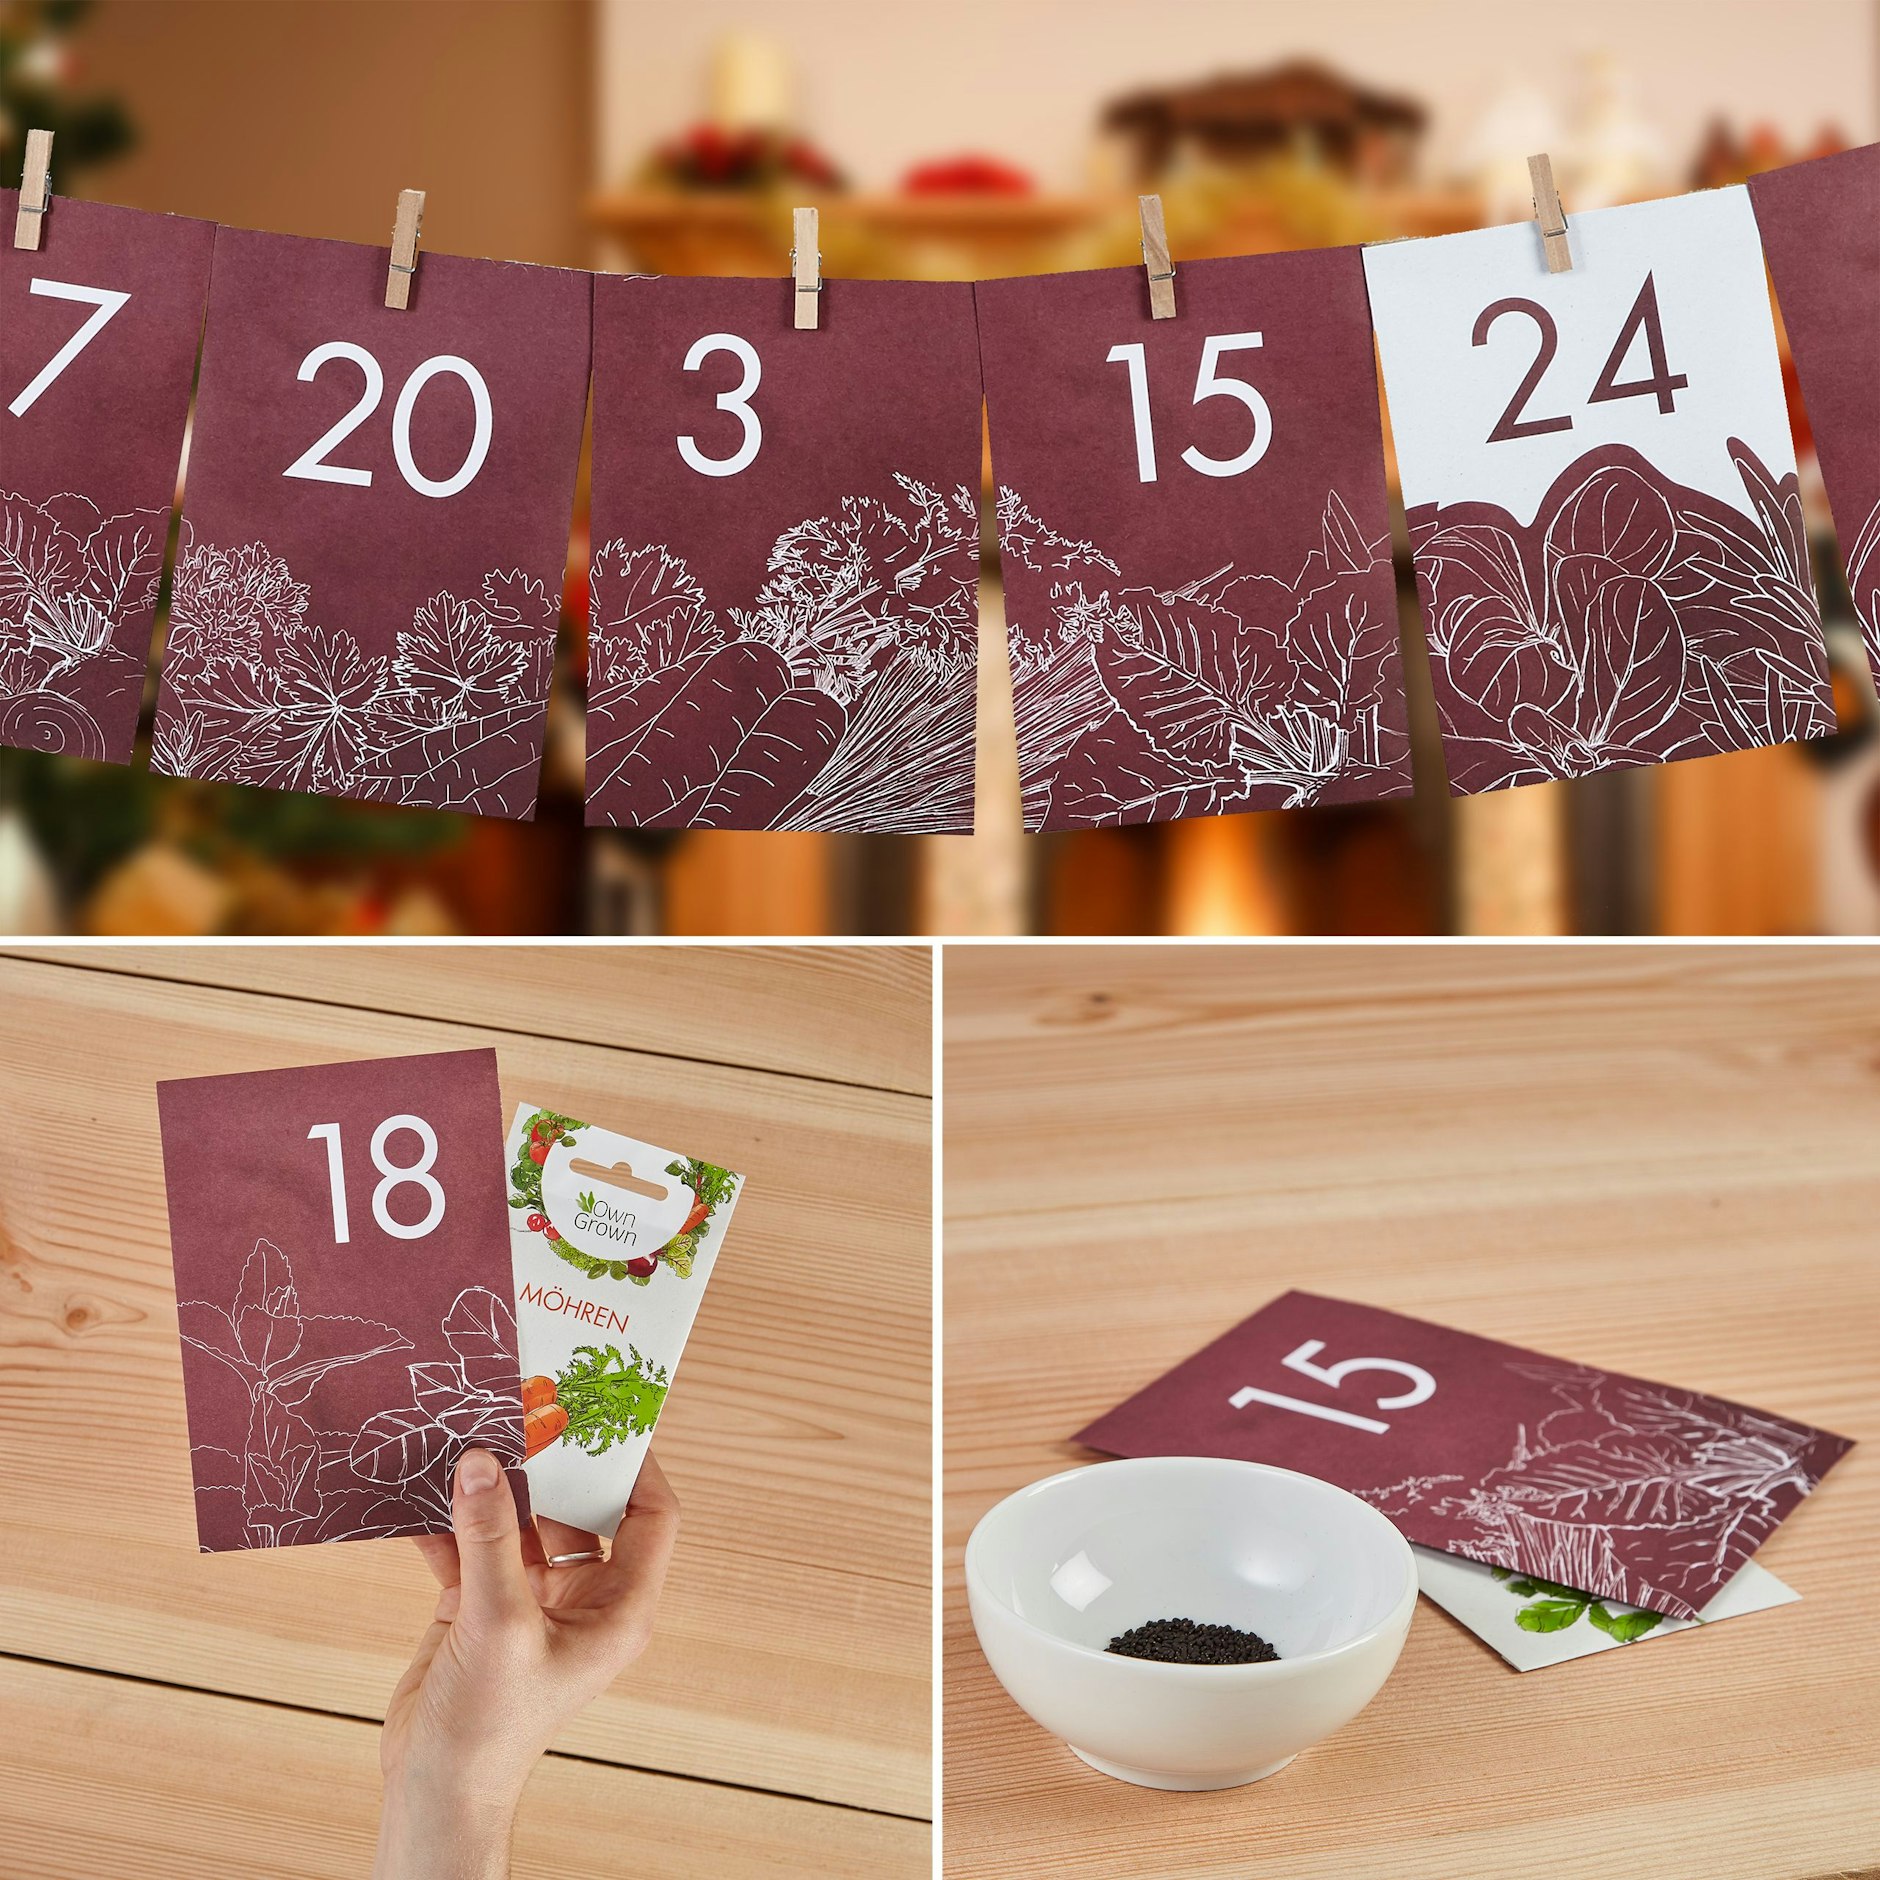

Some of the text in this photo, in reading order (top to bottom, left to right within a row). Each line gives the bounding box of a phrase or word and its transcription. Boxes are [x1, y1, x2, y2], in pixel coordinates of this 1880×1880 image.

[282, 341, 493, 498] 20
[676, 333, 762, 477] 3
[1105, 331, 1272, 483] 15
[1471, 269, 1689, 444] 24
[306, 1114, 446, 1244] 18
[573, 1212, 637, 1247] Grown
[592, 1200, 636, 1228] Own
[519, 1282, 630, 1335] MÖHREN
[1228, 1339, 1437, 1435] 15
